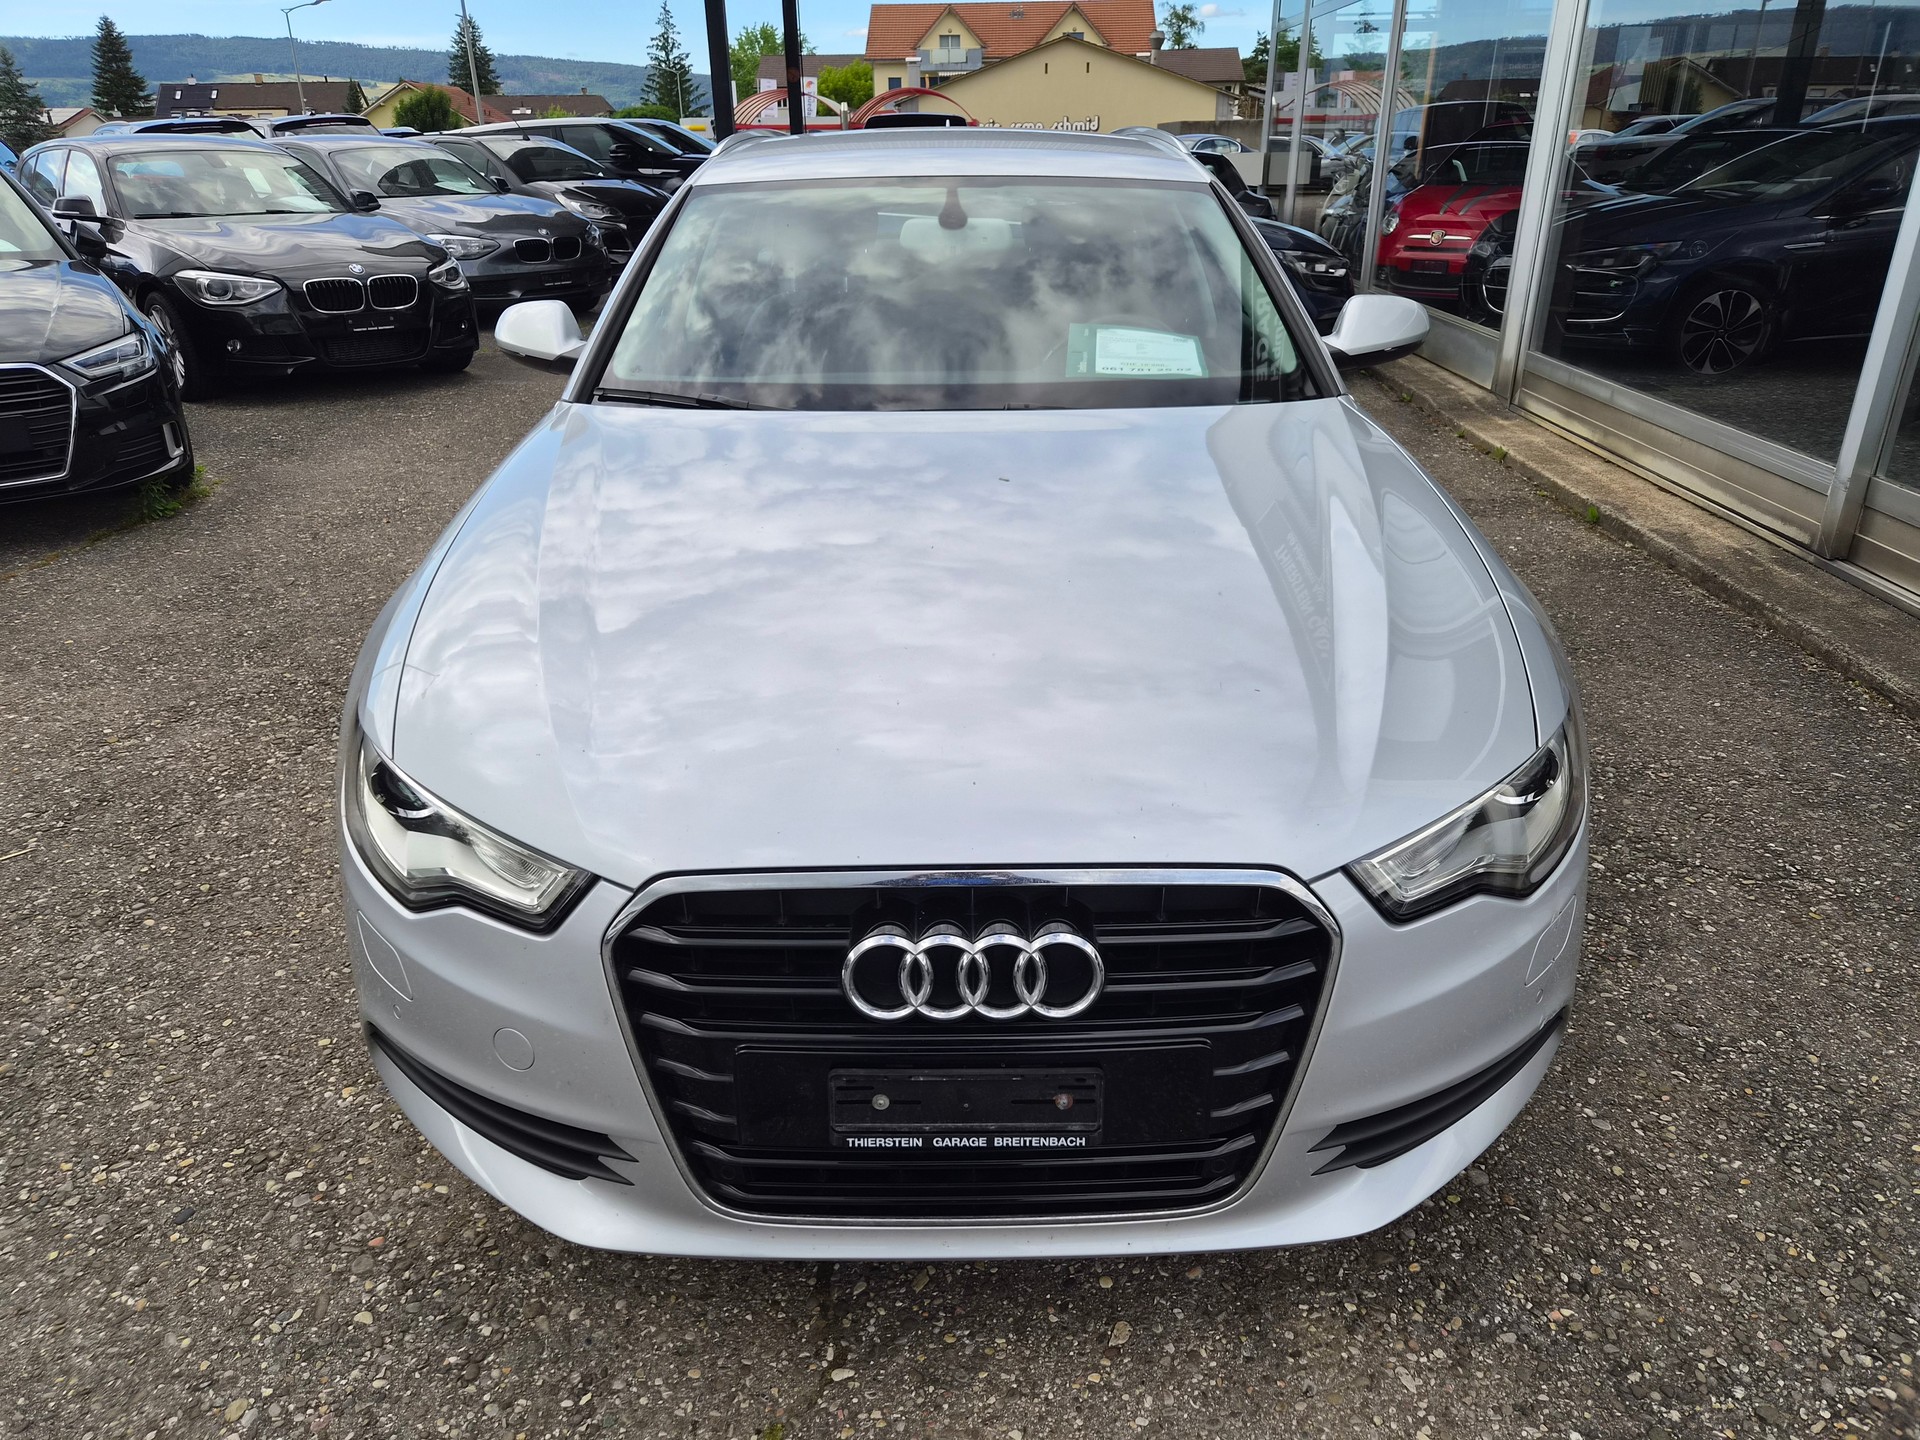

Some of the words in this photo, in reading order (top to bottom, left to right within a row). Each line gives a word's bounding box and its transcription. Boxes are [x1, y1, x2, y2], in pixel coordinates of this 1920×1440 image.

[1050, 115, 1100, 132] schmid
[846, 1137, 923, 1148] THIERSTEIN
[932, 1137, 988, 1148] GARAGE
[994, 1136, 1086, 1147] BREITENBACH
